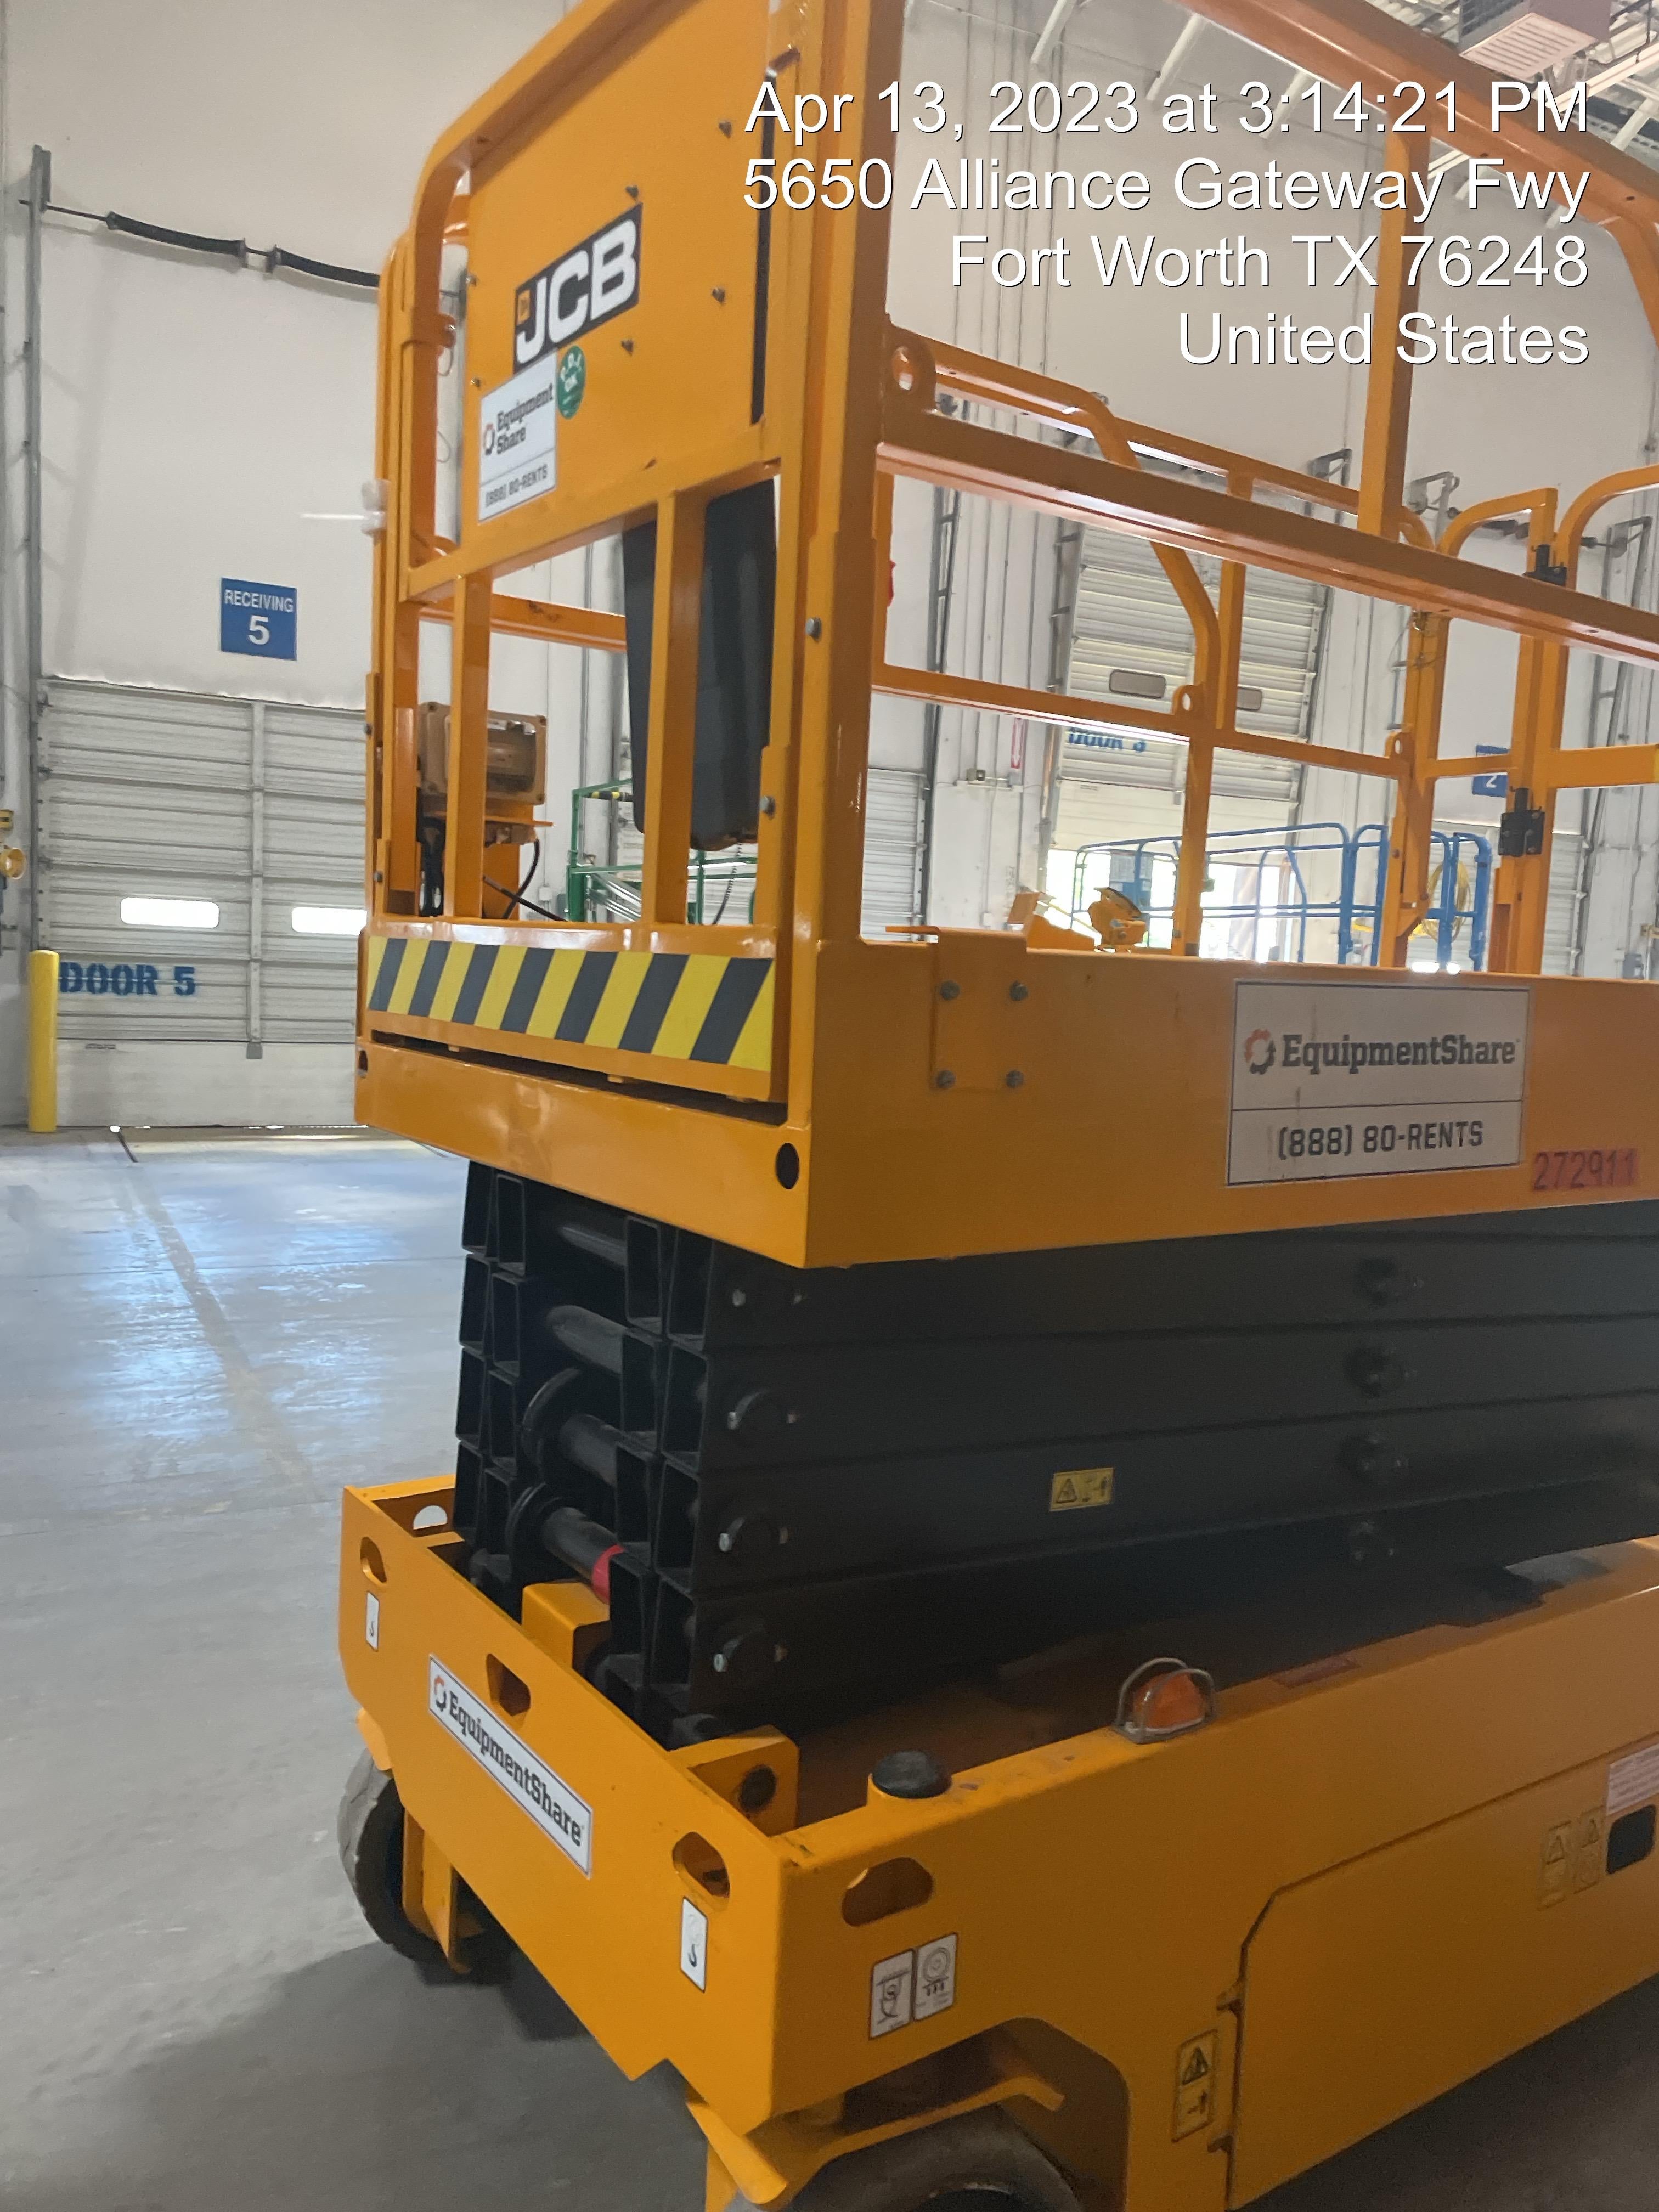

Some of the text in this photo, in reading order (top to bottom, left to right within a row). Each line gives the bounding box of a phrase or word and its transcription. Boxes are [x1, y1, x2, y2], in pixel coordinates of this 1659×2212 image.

[517, 219, 637, 364] JCB
[497, 383, 553, 431] Equipment
[496, 427, 527, 455] Share
[224, 589, 294, 613] RECEIVING
[248, 614, 270, 645] 5
[59, 962, 196, 995] DOOR 5
[1282, 1034, 1516, 1075] EquipmentShare
[1278, 1121, 1484, 1160] (888) 80-RENTS
[1534, 1149, 1636, 1190] 272911
[449, 1690, 582, 1847] EquipmentShare
